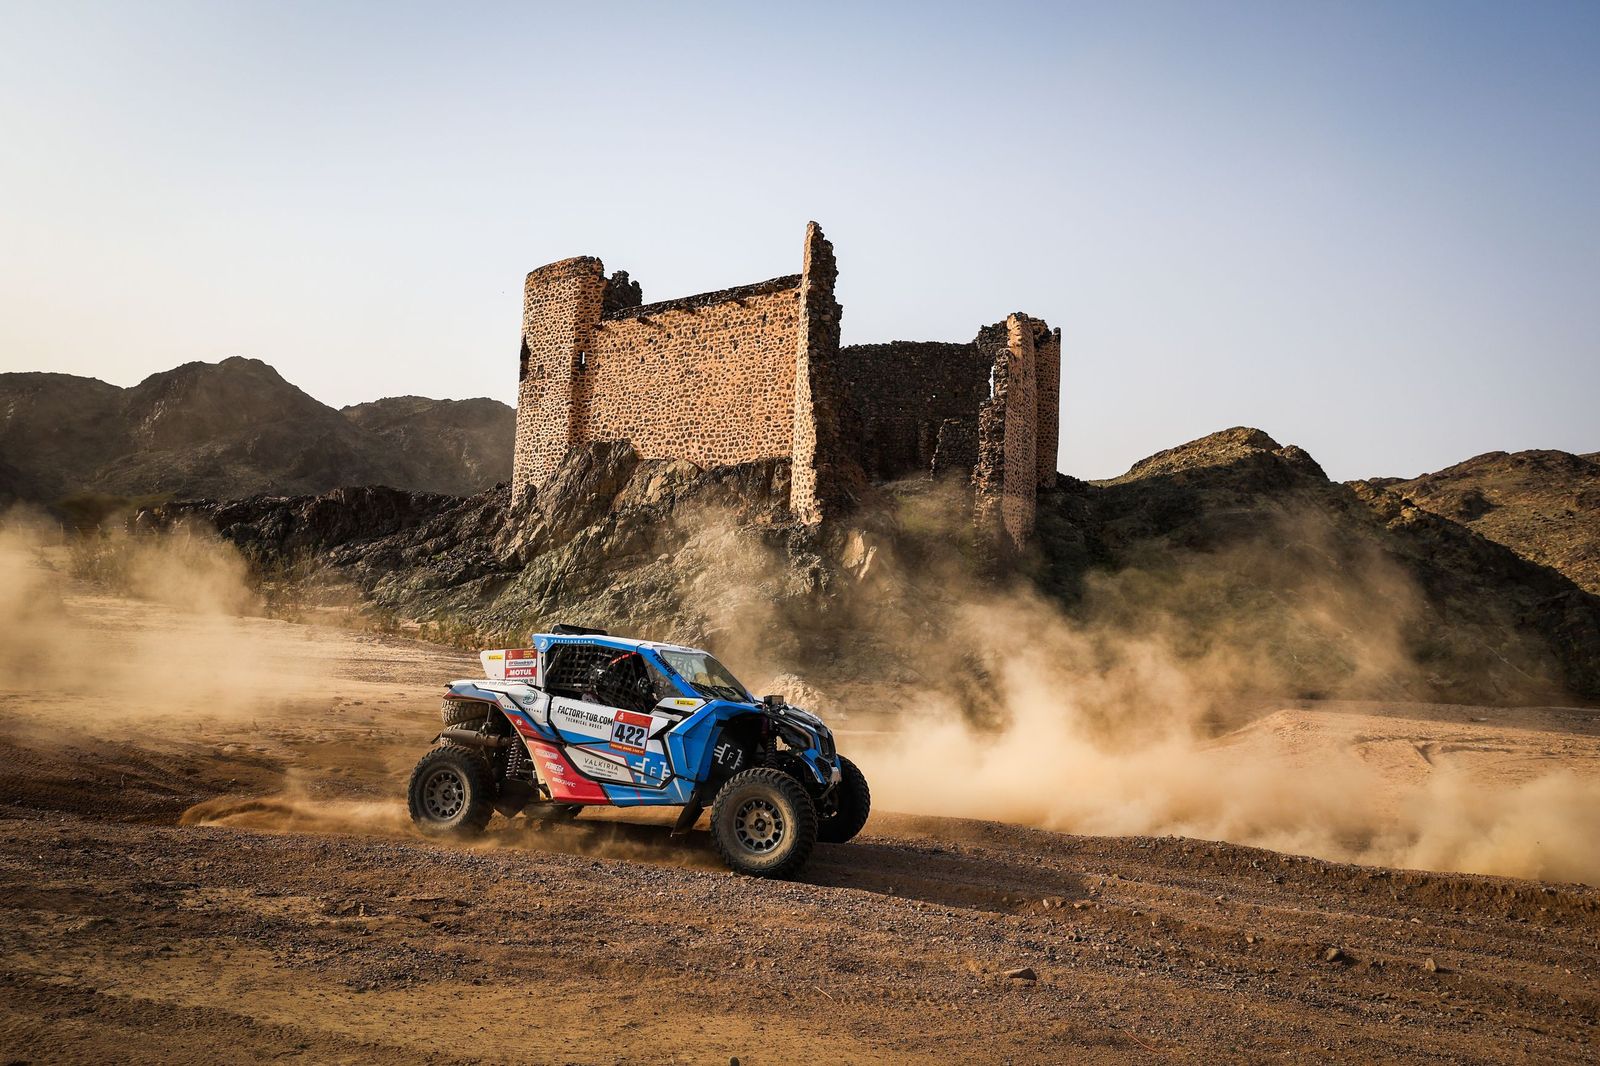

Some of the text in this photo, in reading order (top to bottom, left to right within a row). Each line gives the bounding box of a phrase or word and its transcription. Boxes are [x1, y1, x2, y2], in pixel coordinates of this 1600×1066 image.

[557, 705, 613, 726] FACTORY-TUB.COM
[565, 717, 588, 726] TECHNICAL
[614, 723, 645, 747] 422
[726, 751, 734, 760] F
[584, 757, 619, 772] VALKIRIA
[649, 766, 657, 776] F
